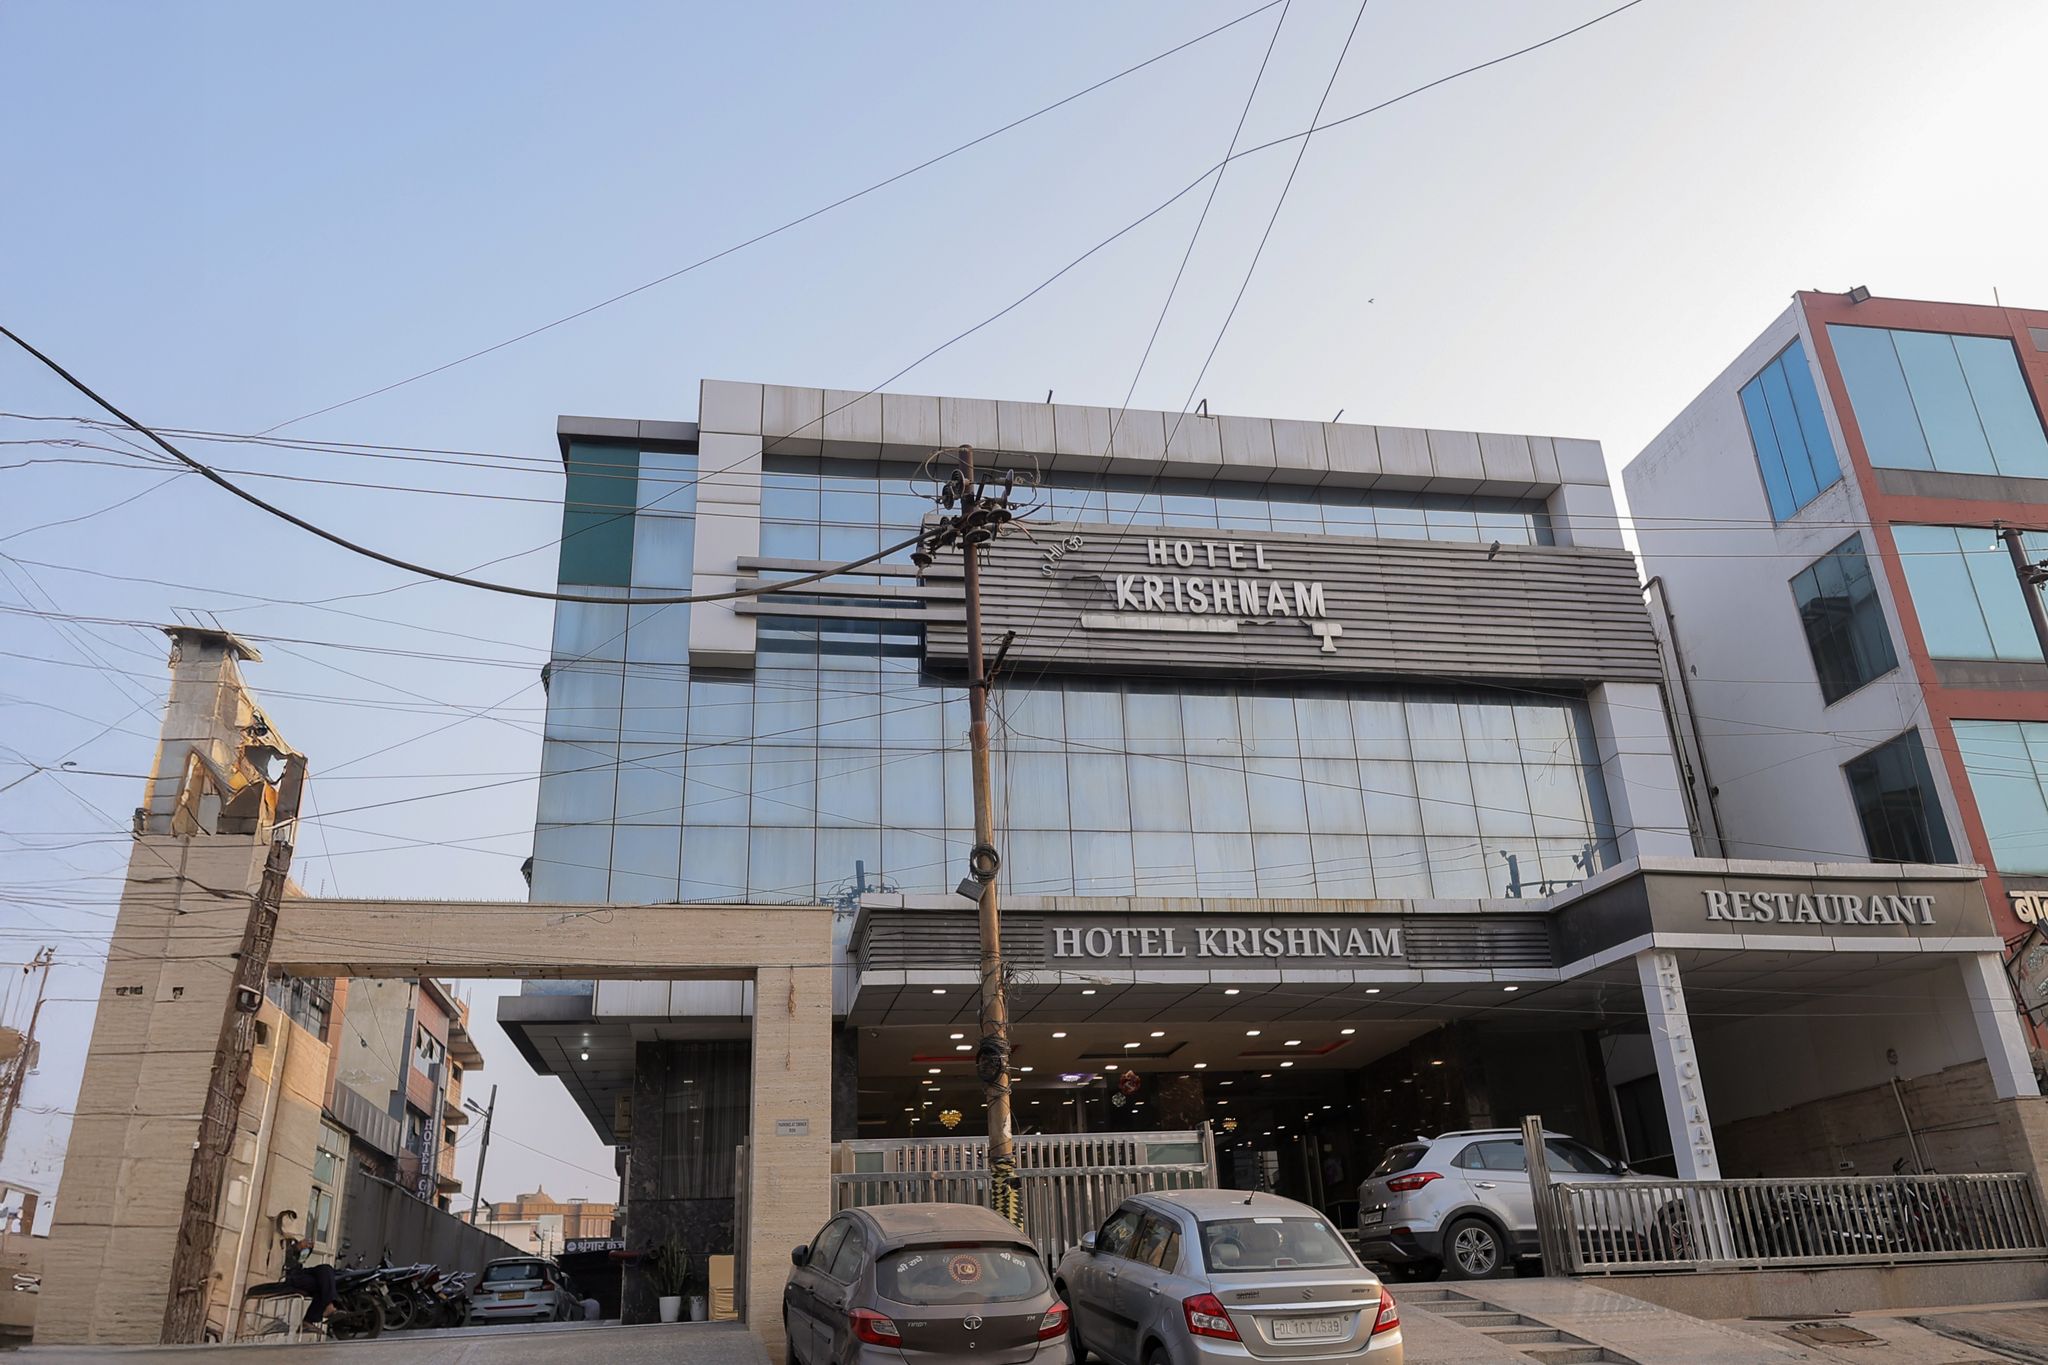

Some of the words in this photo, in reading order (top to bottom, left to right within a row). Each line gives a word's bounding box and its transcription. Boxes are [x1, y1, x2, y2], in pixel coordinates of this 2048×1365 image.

[1147, 538, 1272, 571] HOTEL
[1116, 574, 1327, 618] KRISHNAM
[1702, 889, 1937, 925] RESTAURANT
[1052, 927, 1187, 958] HOTEL
[1195, 927, 1404, 958] KRISHNAM
[421, 1119, 434, 1175] HOTEL
